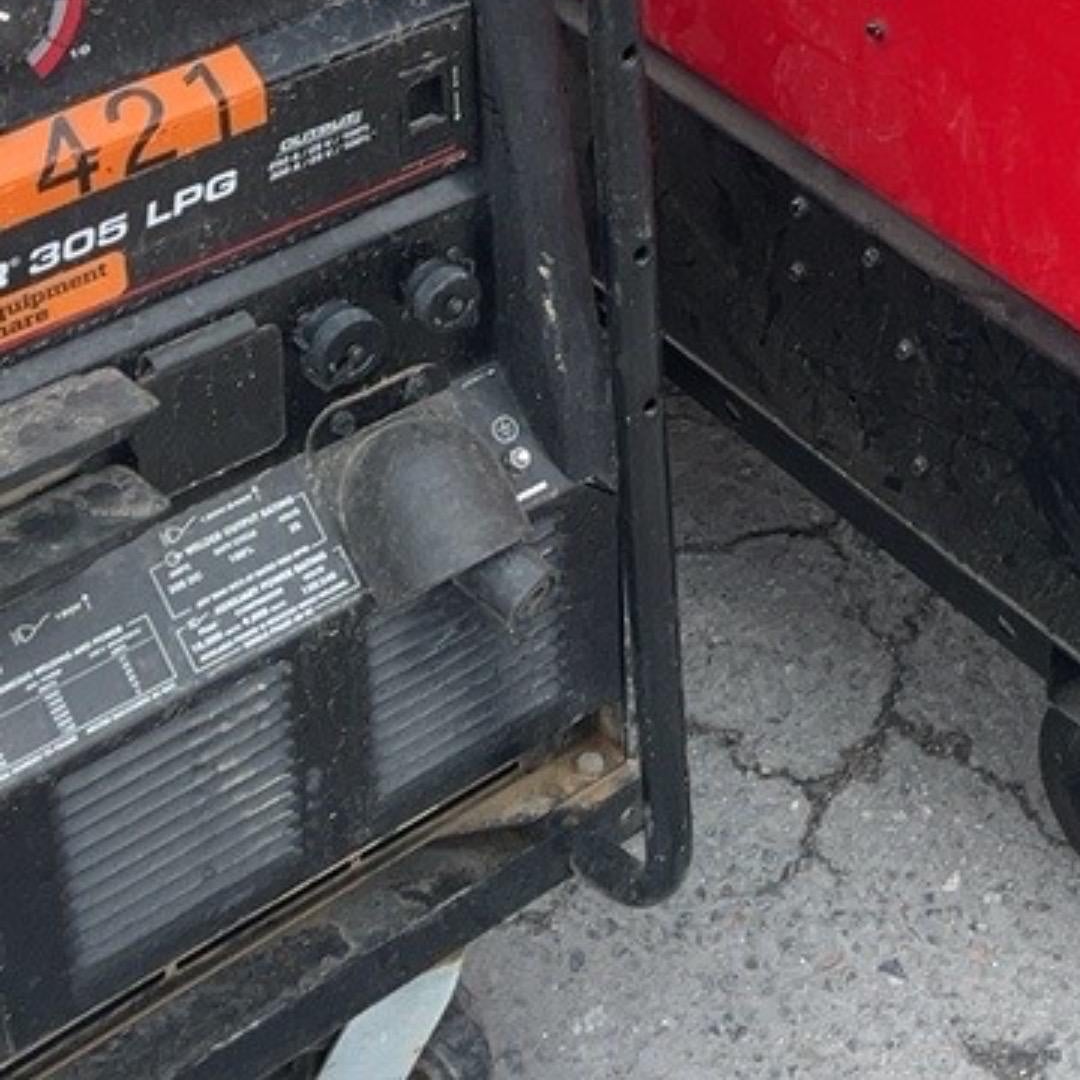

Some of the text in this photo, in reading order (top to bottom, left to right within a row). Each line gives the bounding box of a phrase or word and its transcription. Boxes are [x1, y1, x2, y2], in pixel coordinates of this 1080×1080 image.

[36, 61, 234, 195] 421
[29, 212, 129, 275] 305
[147, 168, 239, 229] LPG
